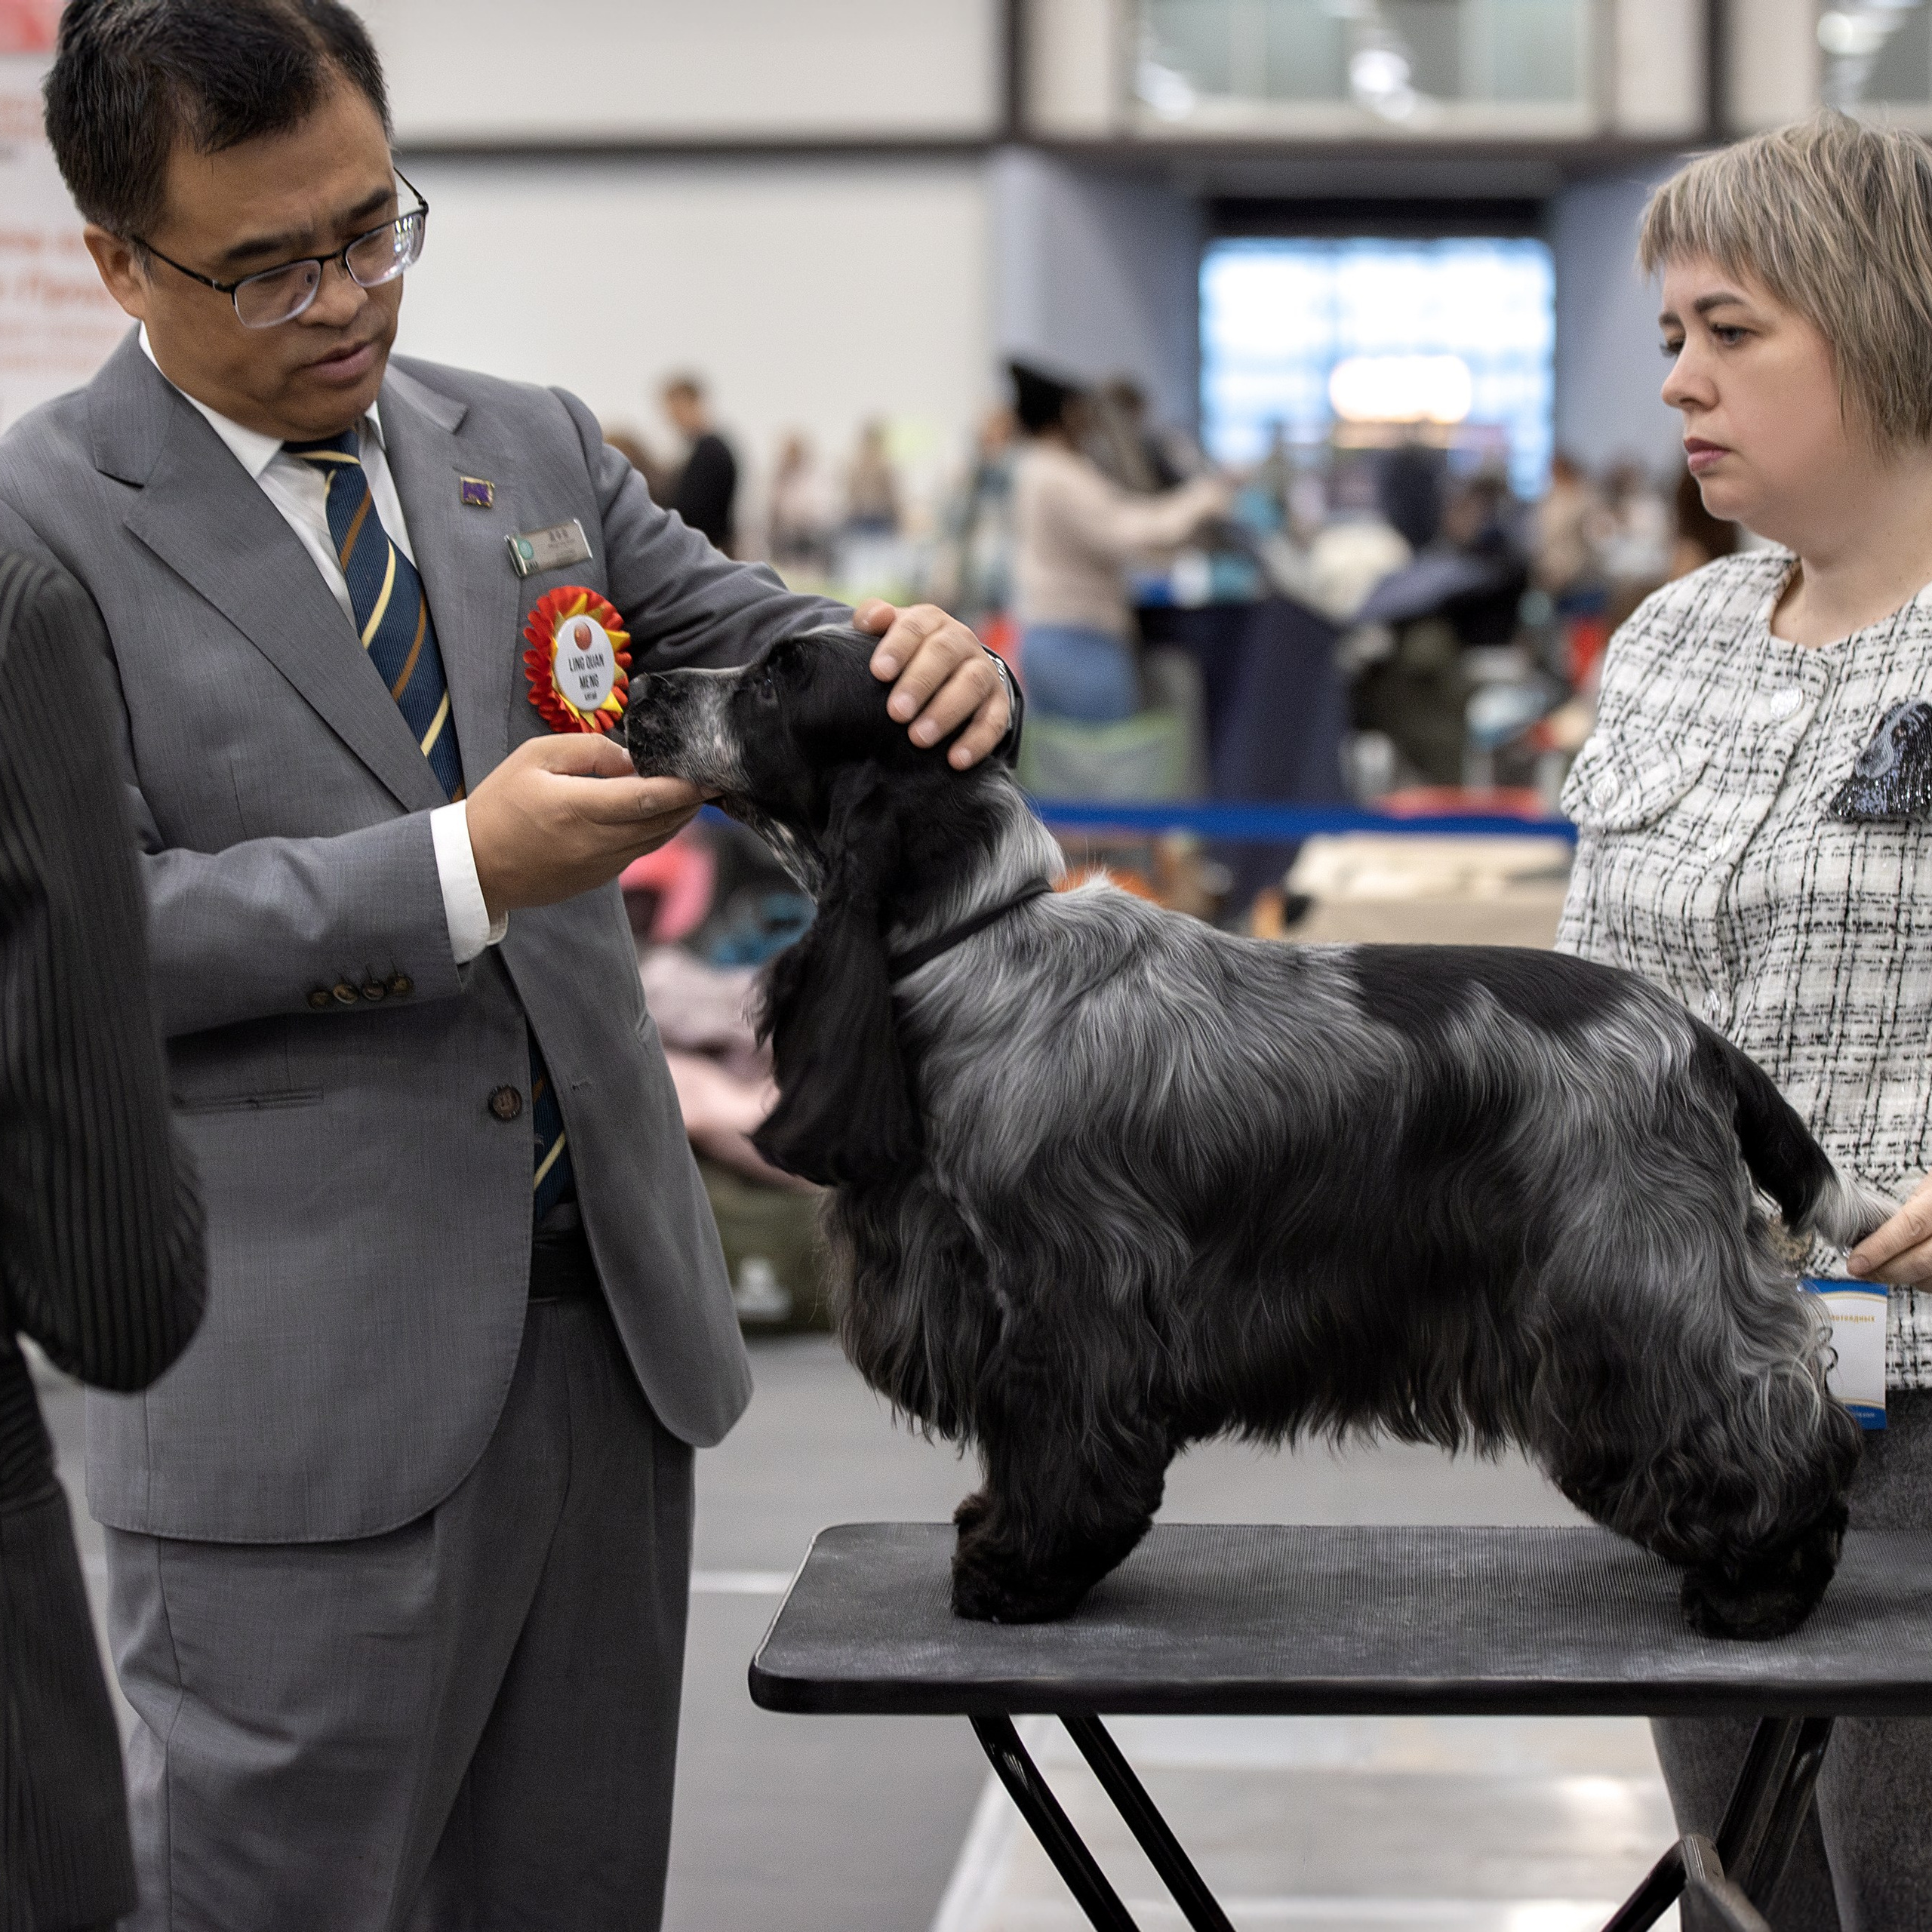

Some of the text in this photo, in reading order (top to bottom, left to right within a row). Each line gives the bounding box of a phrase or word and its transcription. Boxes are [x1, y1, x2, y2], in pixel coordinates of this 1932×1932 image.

[568, 654, 604, 672] LING QUAN
[579, 674, 599, 690] MENG
